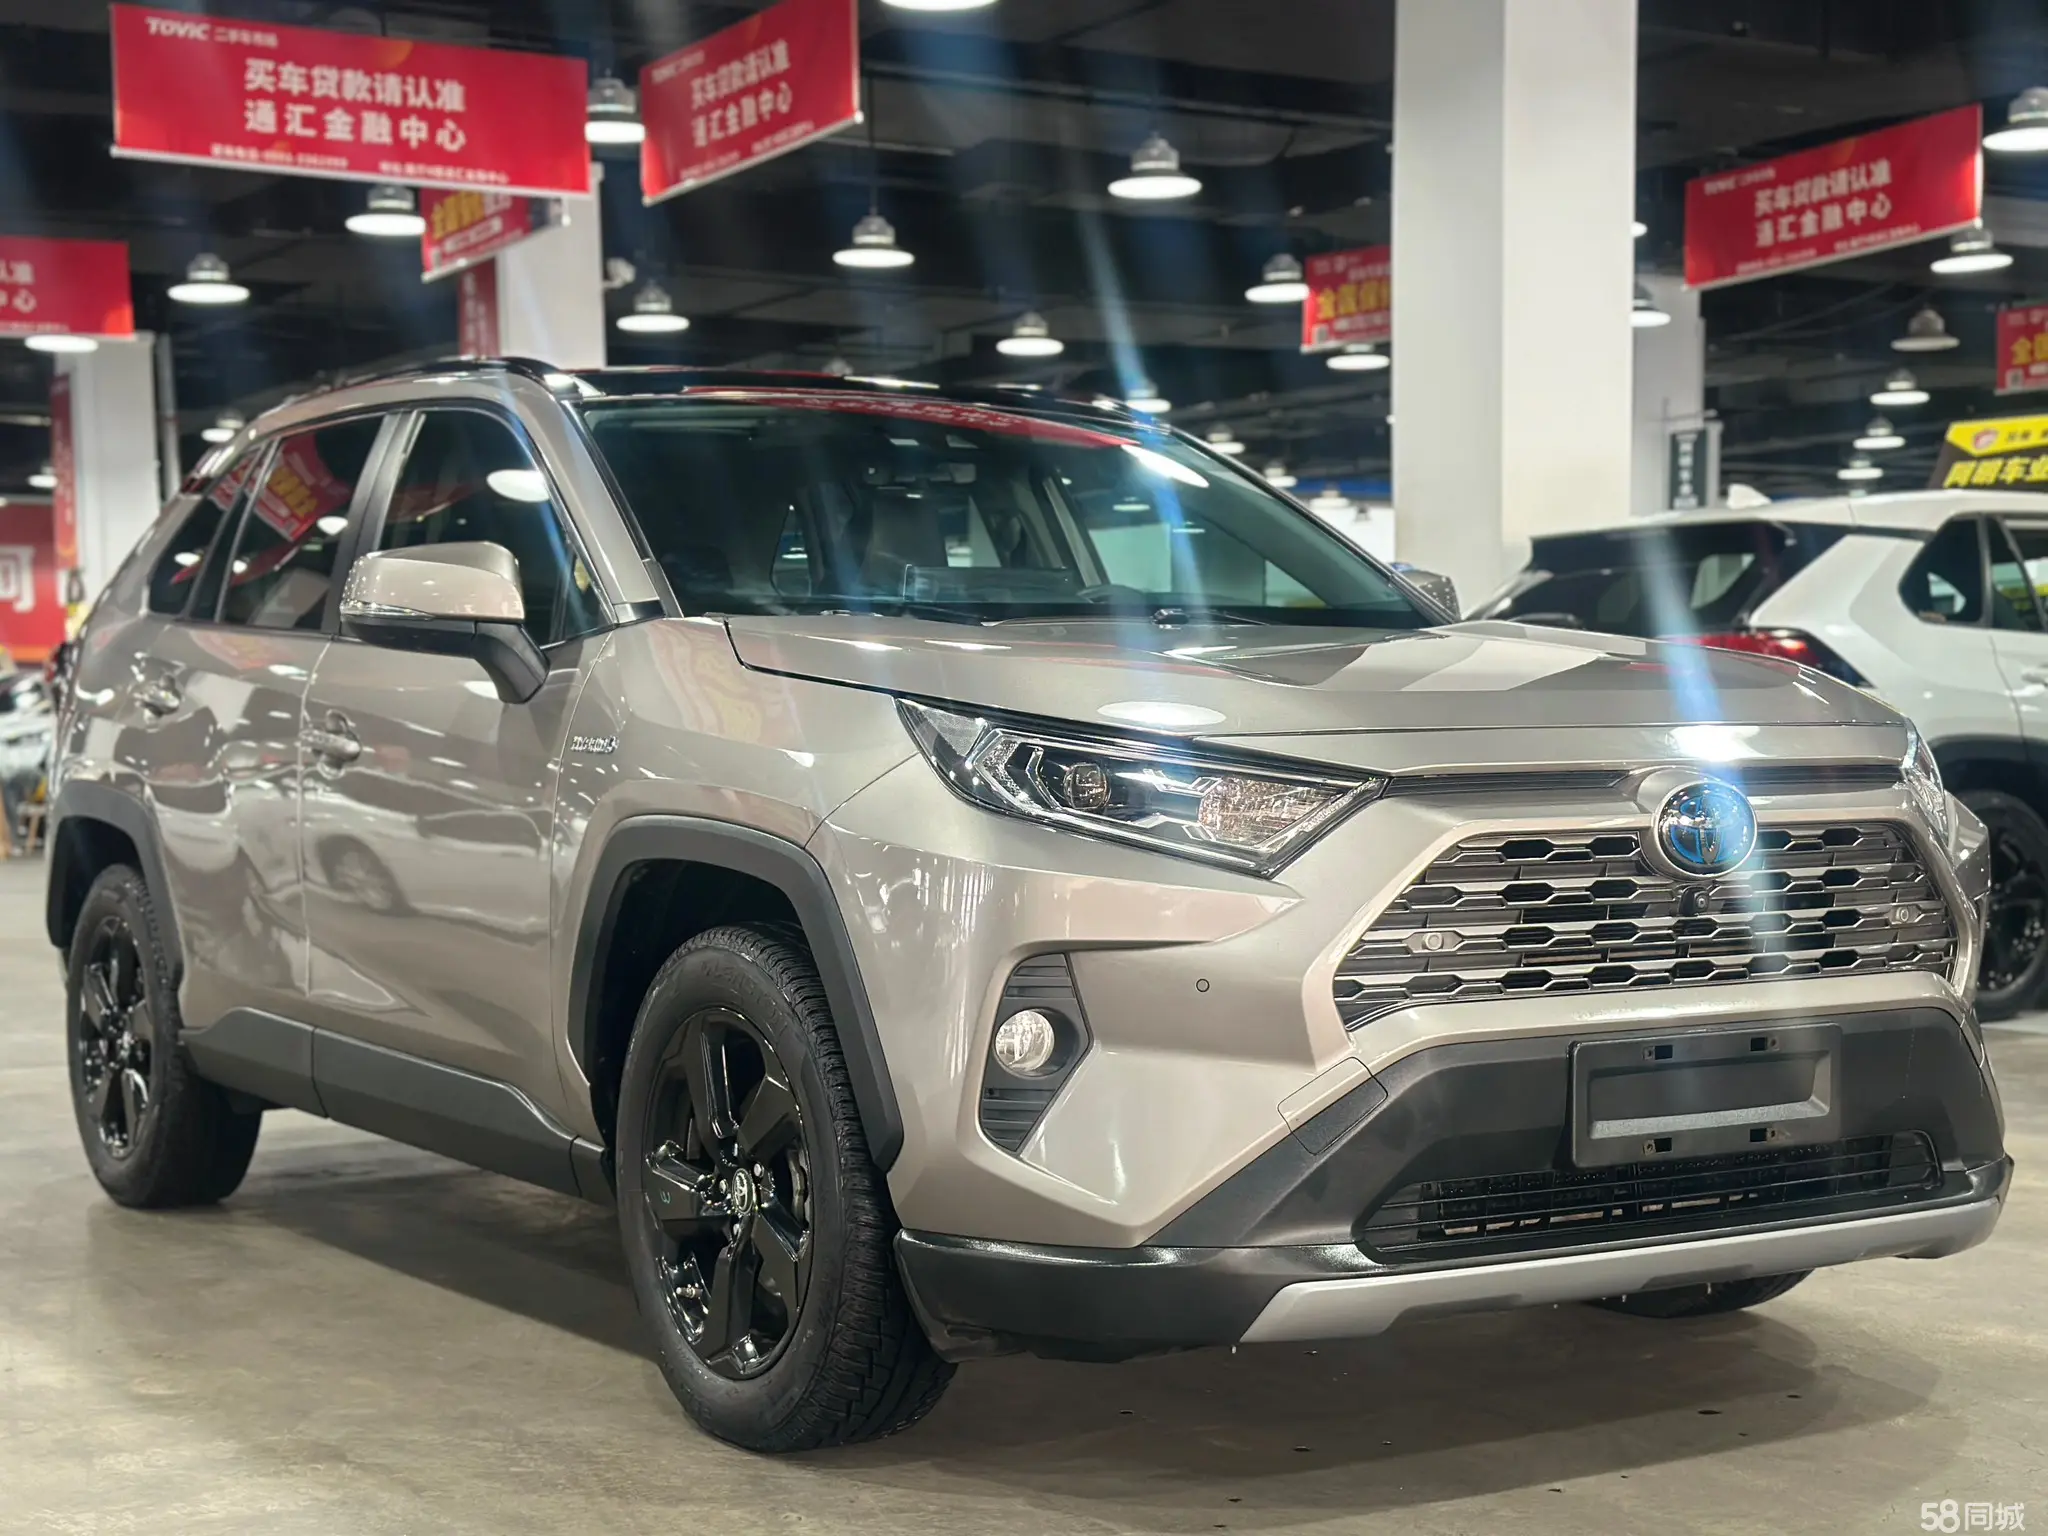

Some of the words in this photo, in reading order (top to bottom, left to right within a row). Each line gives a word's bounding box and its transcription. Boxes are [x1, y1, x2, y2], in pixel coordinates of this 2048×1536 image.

[145, 16, 211, 41] TOVIC
[245, 57, 466, 112] 买车贷款请认准
[245, 99, 466, 152] 通汇金融中心
[1754, 157, 1892, 218] 买车贷款请认准
[1755, 193, 1892, 248] 通汇金融中心
